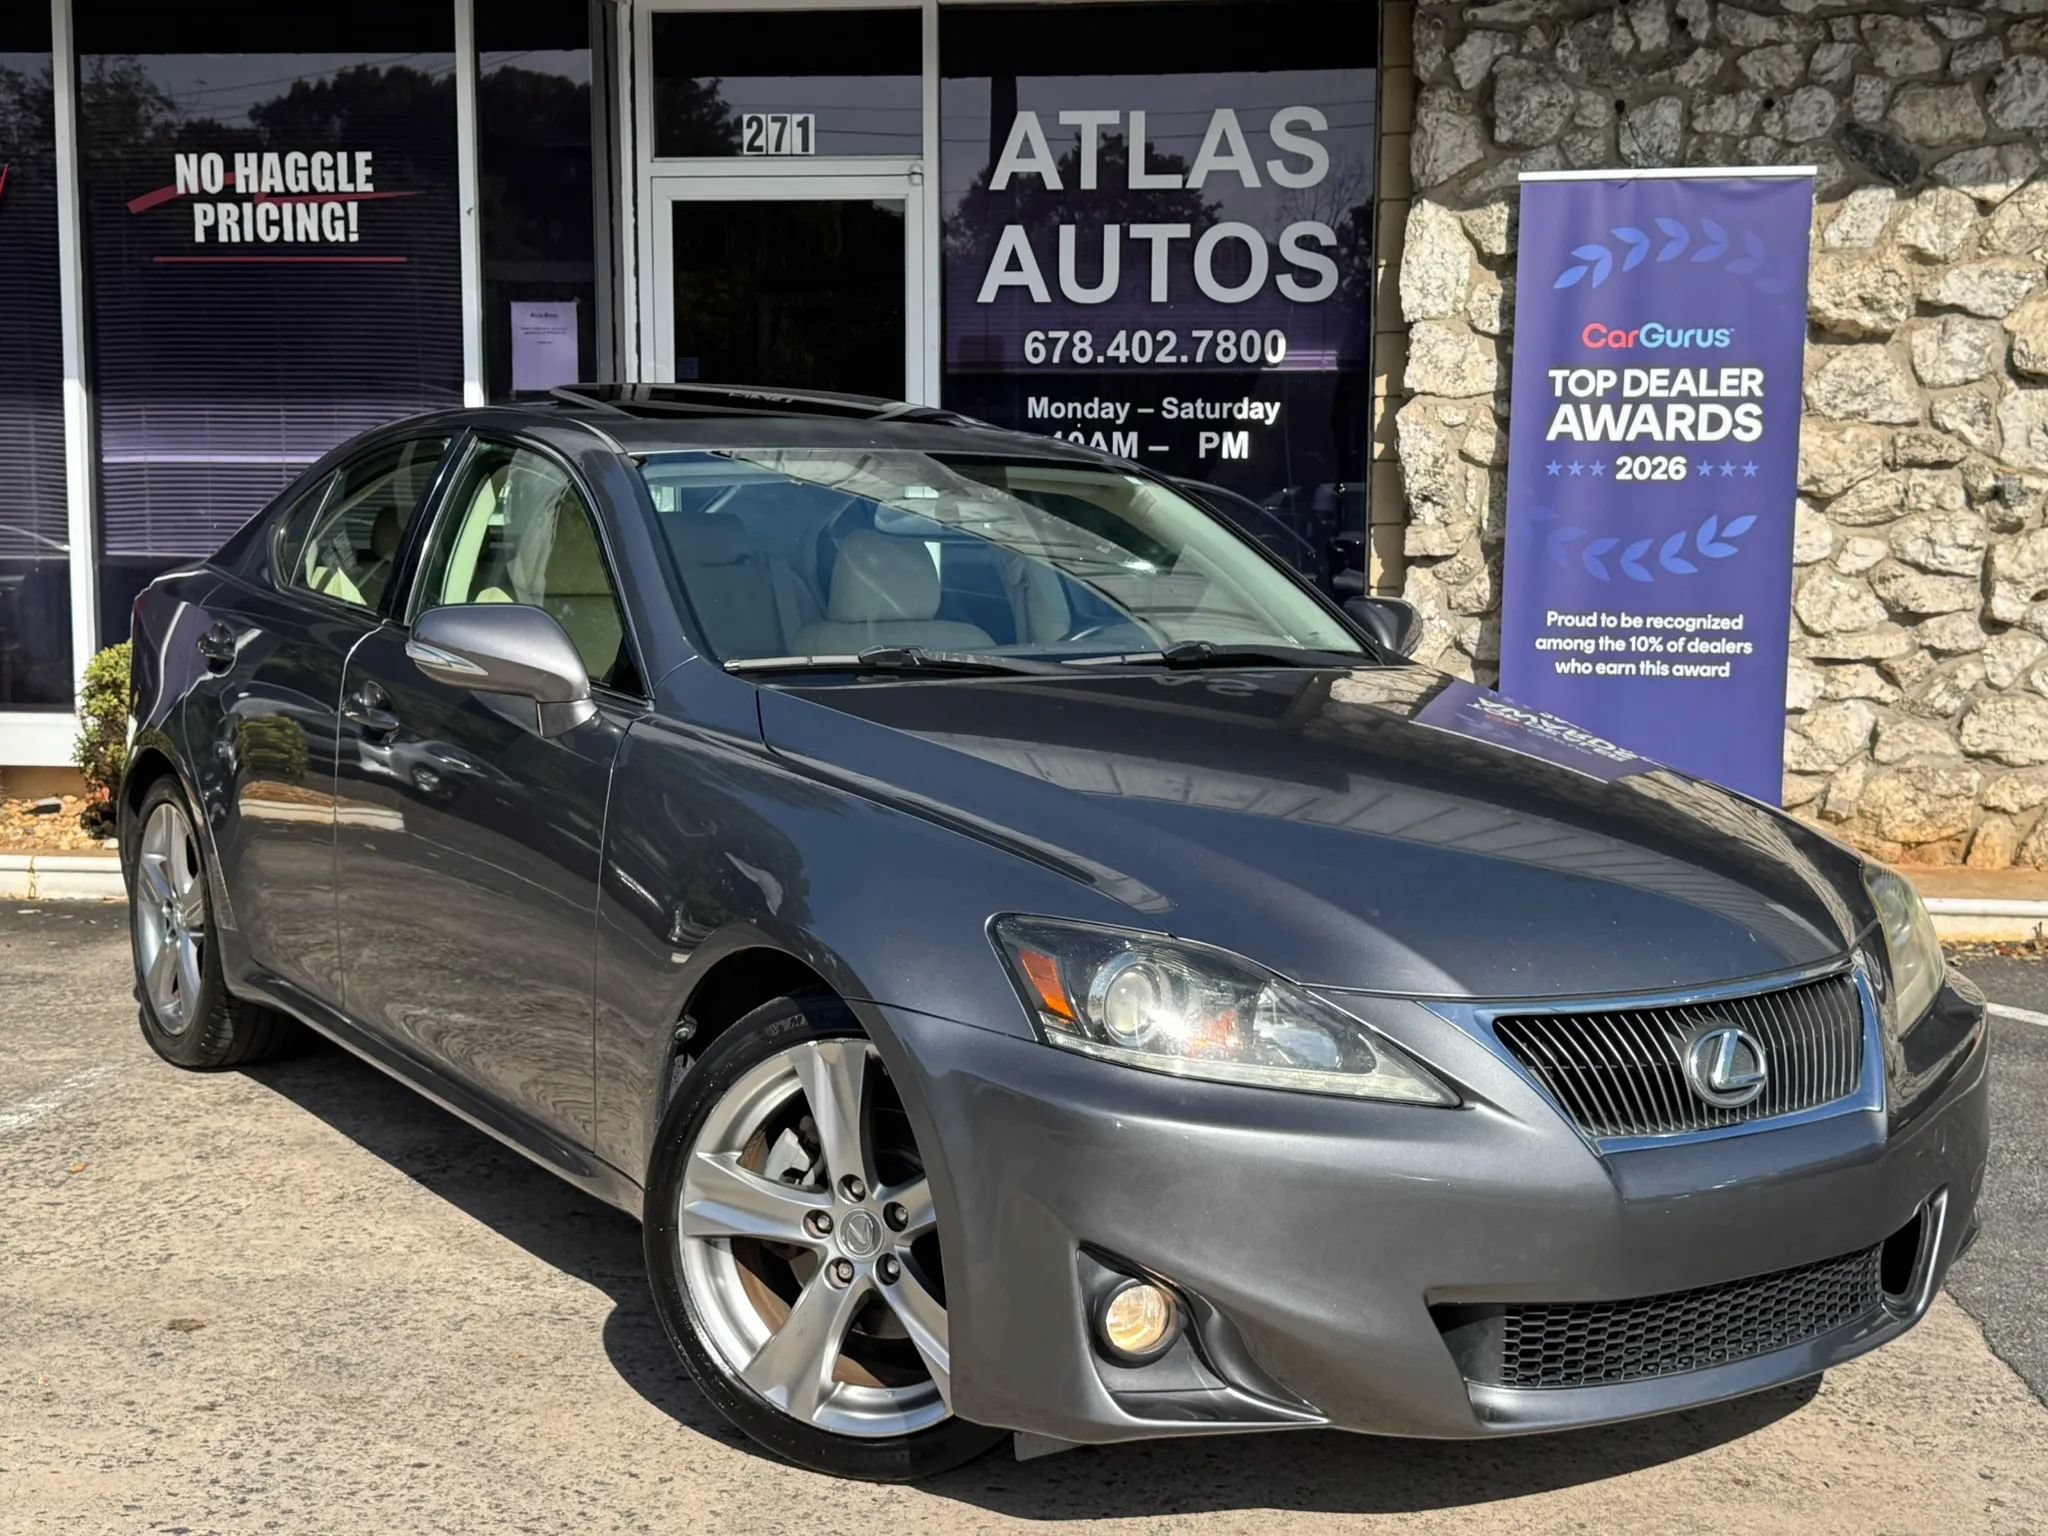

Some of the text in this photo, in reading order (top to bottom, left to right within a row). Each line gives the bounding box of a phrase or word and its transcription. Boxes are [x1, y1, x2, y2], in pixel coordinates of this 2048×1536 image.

[746, 115, 813, 153] 271
[989, 106, 1329, 190] ATLAS
[175, 151, 374, 195] NO HAGGLE
[193, 202, 359, 243] PRICING!
[977, 221, 1339, 304] AUTOS
[1024, 330, 1287, 364] 678.402.7800
[1582, 322, 1732, 348] CarGurus
[1548, 368, 1764, 398] TOP DEALER
[1027, 396, 1131, 425] Monday
[1161, 396, 1281, 425] Saturday
[1546, 402, 1763, 442] AWARDS
[1199, 431, 1249, 459] PM
[1615, 455, 1687, 481] 2026
[1547, 610, 1744, 632] Proud to be recognized
[1535, 635, 1753, 655] among the 10% of dealers
[1555, 658, 1731, 678] who earn this award
